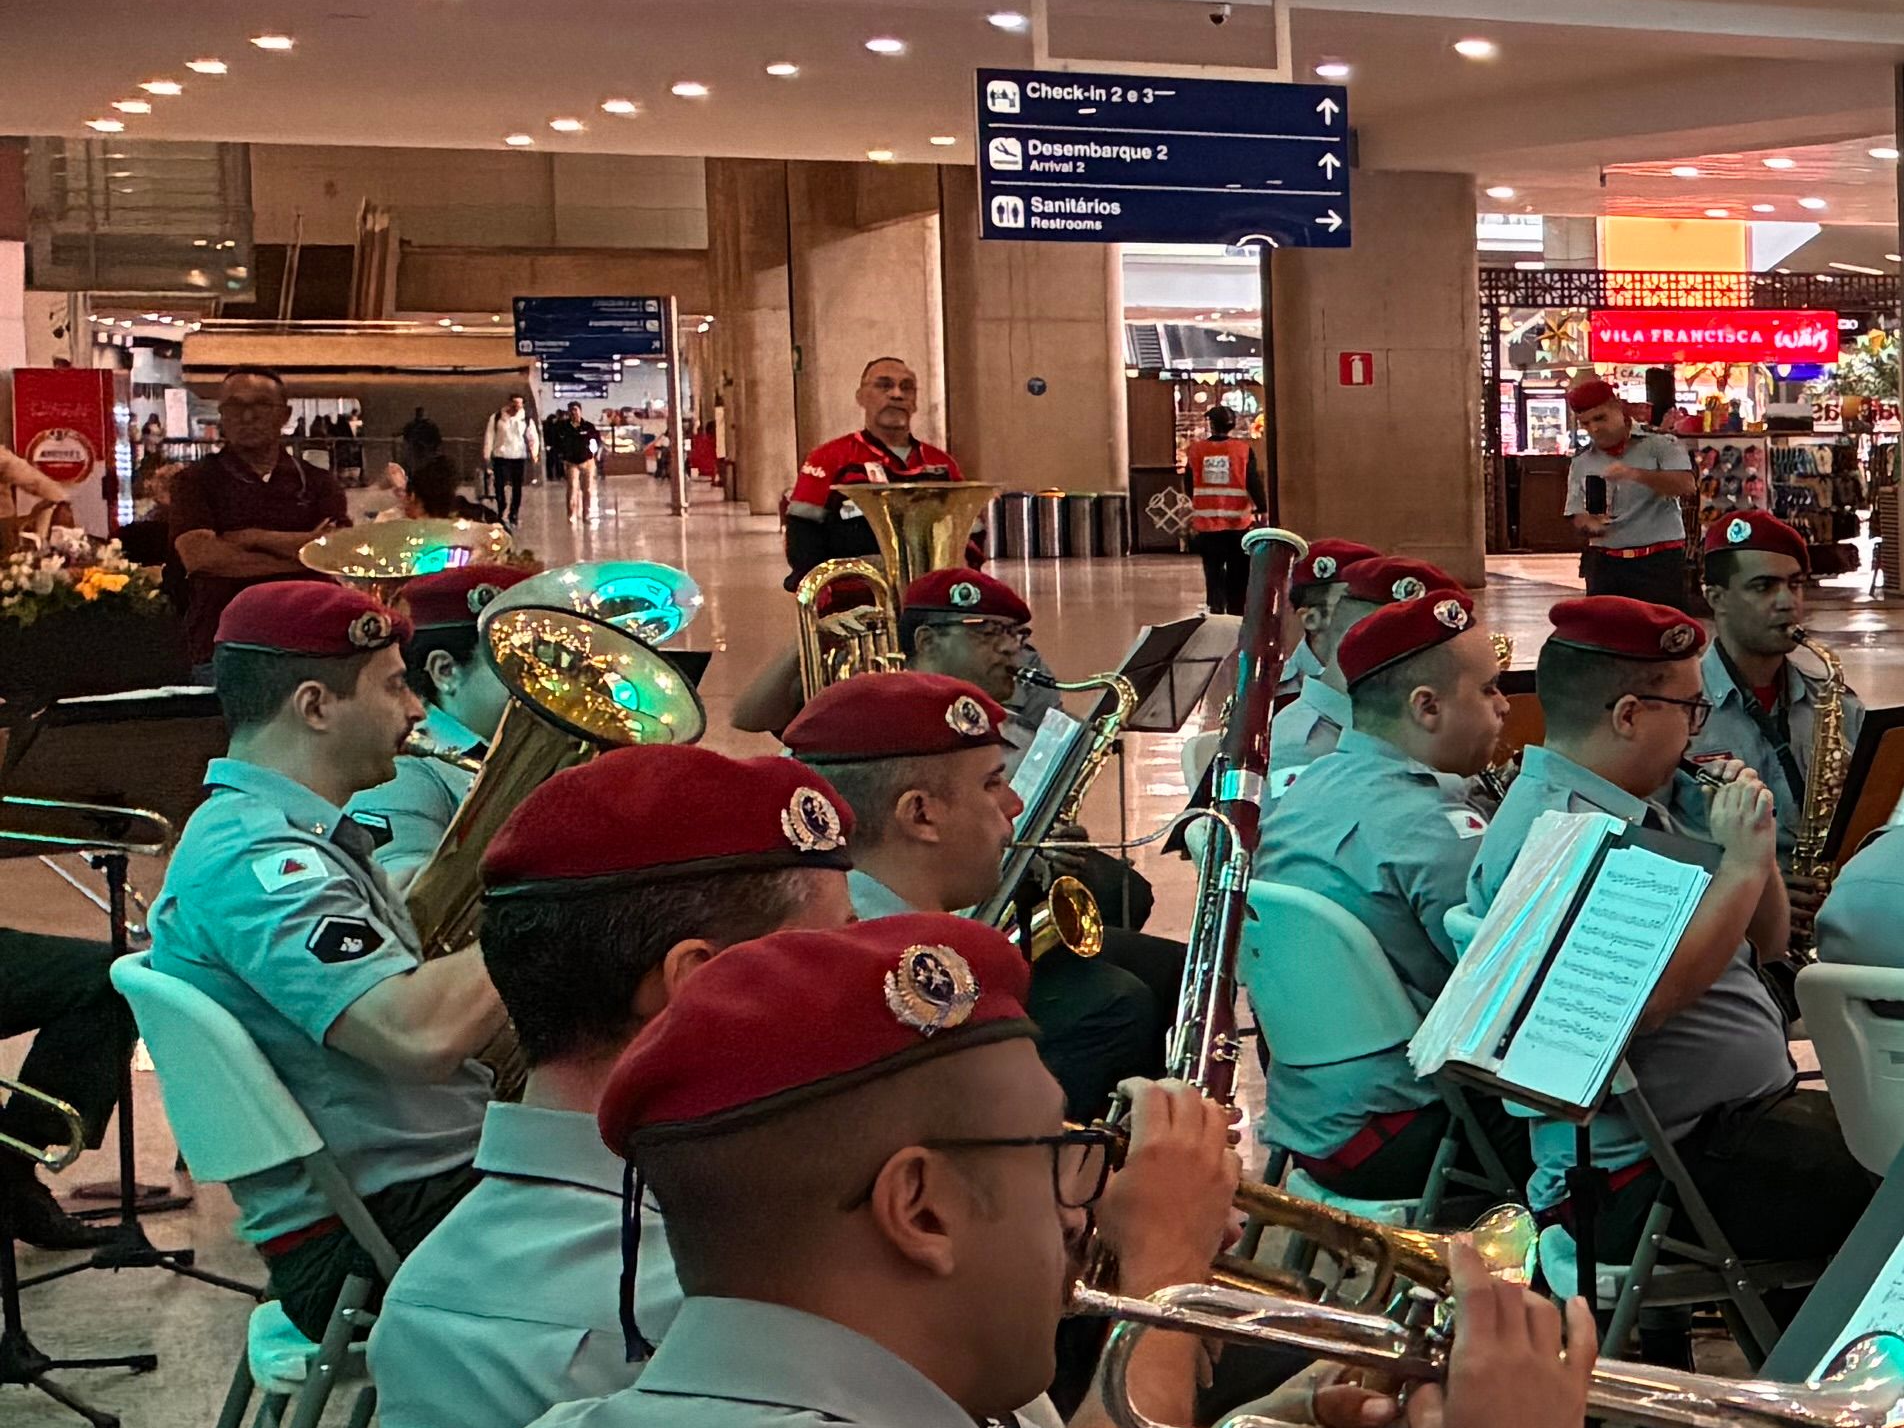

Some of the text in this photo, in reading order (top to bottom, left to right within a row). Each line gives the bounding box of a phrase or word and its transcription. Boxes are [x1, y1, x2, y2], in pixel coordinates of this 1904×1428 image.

[1026, 82, 1154, 103] Check-in 2 e 3
[1028, 140, 1168, 161] Desembarque 2
[1029, 160, 1085, 173] Arrival 2
[1030, 197, 1121, 215] Sanitários
[1031, 217, 1102, 231] Restrooms
[1600, 329, 1642, 343] VILA
[1651, 329, 1763, 344] FRANCISCA
